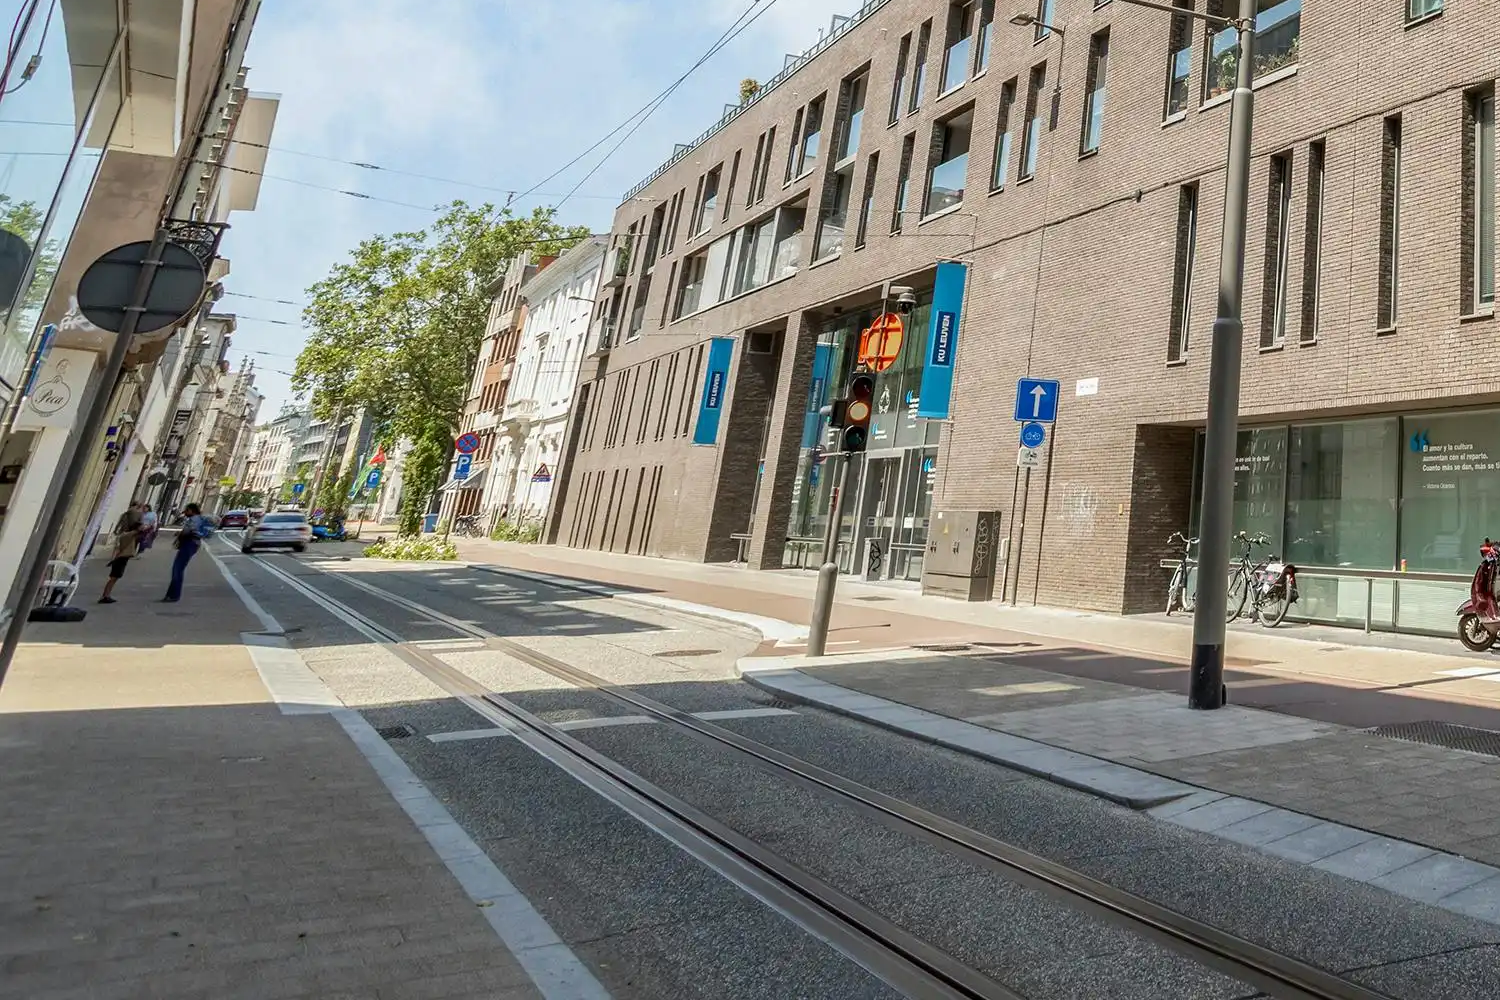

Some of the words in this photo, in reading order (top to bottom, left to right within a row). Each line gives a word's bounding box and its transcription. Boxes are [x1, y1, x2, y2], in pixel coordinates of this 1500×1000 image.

[939, 315, 950, 347] LEUVEN
[937, 349, 945, 362] KU
[711, 373, 721, 397] LEUVEN
[709, 397, 716, 407] KU
[1454, 443, 1473, 451] cultura
[458, 456, 470, 470] P
[1422, 464, 1441, 472] Cuanto
[369, 470, 379, 482] P
